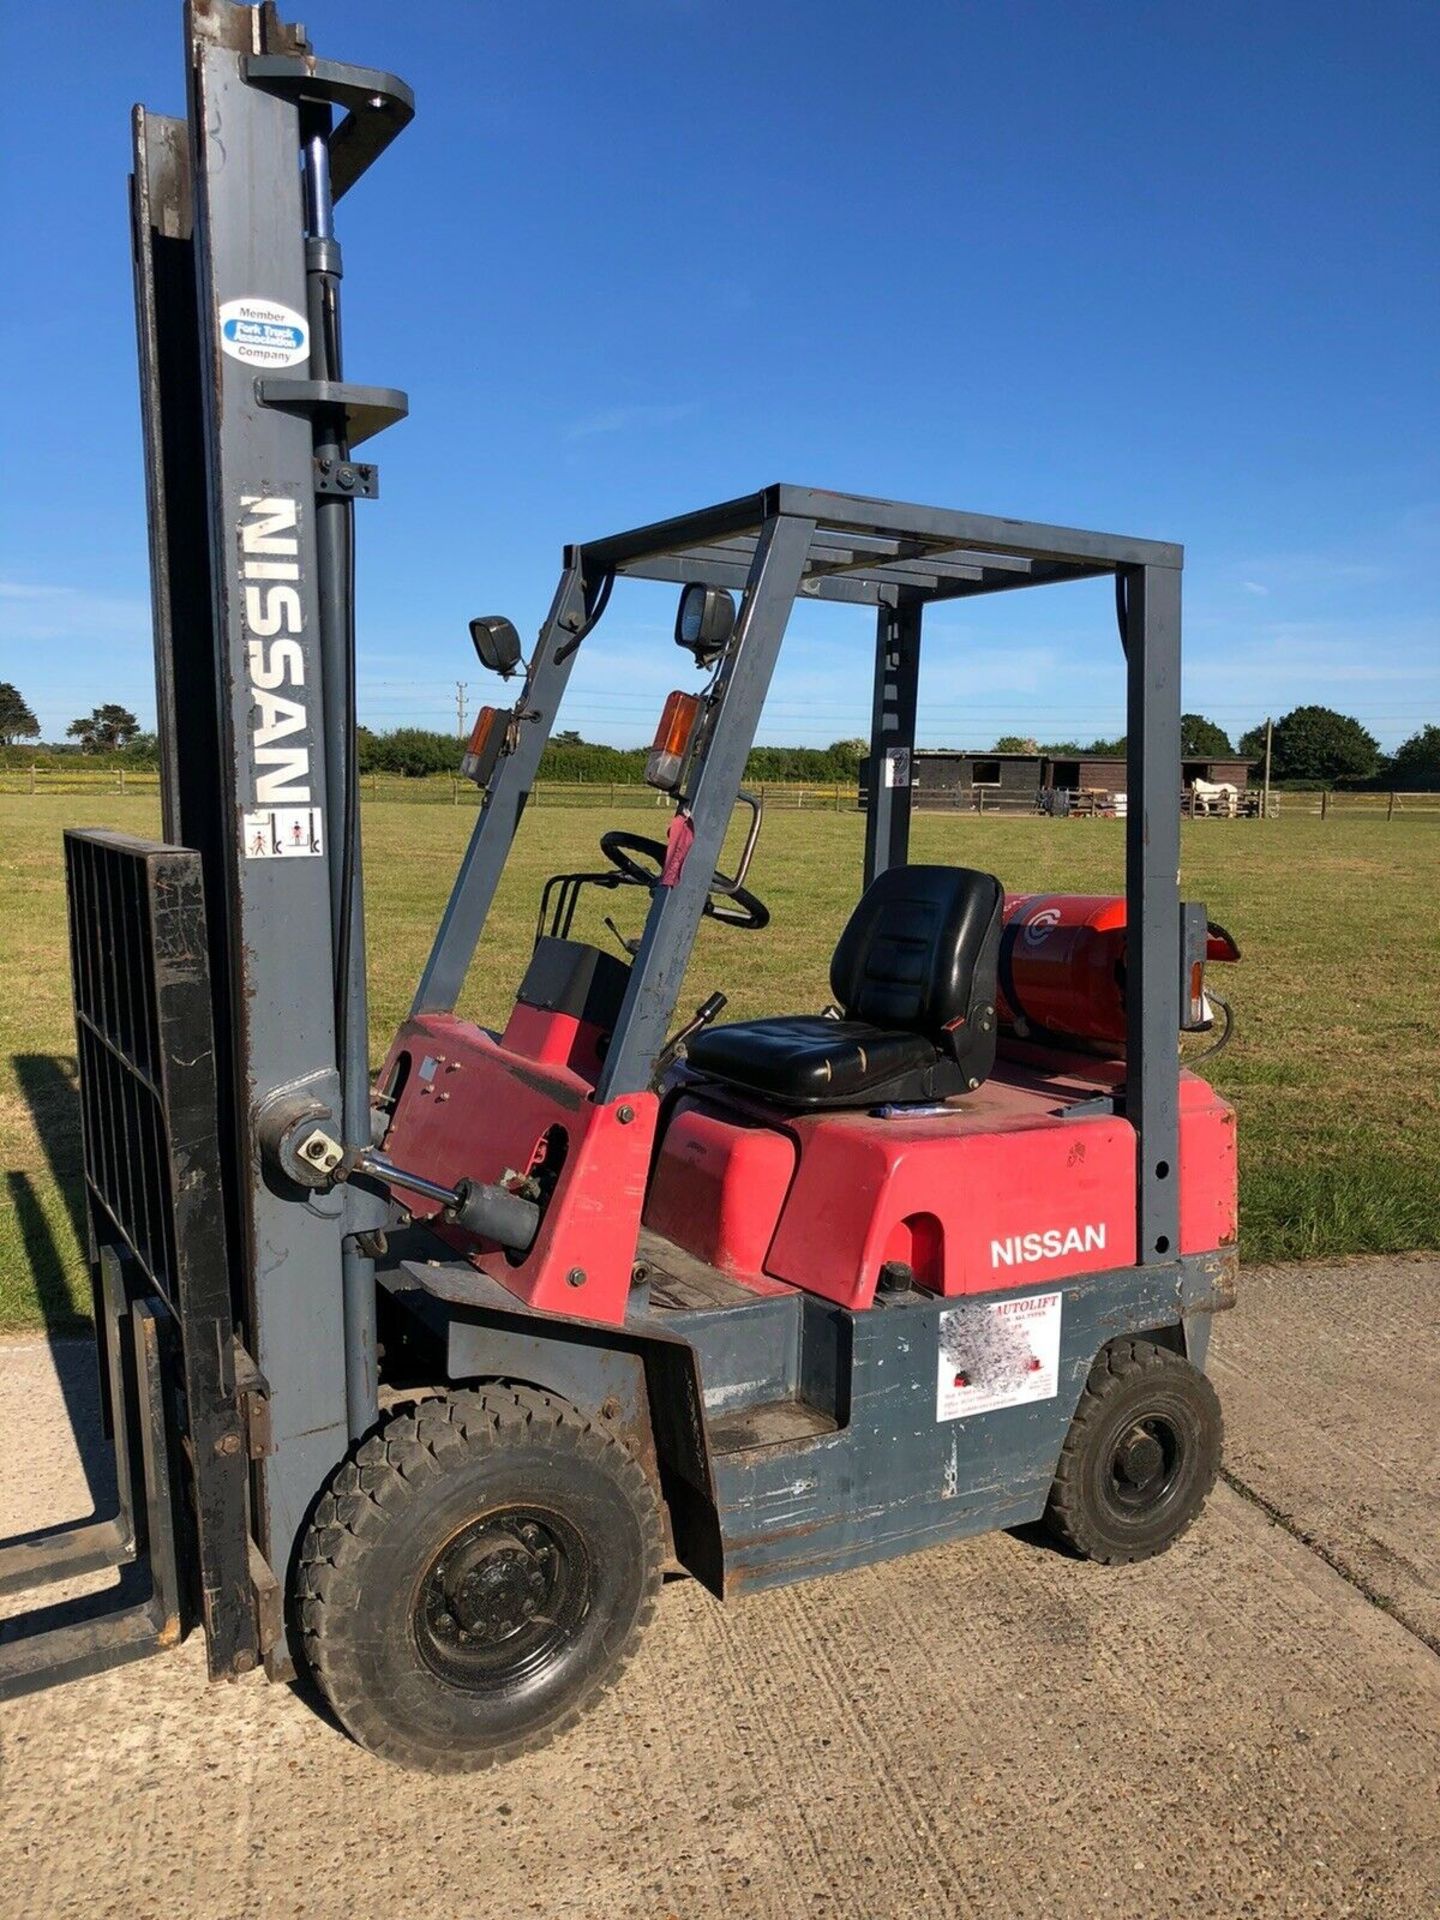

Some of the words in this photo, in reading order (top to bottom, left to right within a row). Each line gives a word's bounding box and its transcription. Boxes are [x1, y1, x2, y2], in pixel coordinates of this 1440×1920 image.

[240, 307, 285, 322] Member
[238, 346, 291, 362] Company
[240, 496, 311, 803] NISSAN
[991, 1222, 1106, 1269] NISSAN
[996, 1295, 1059, 1316] AUTOLIFT
